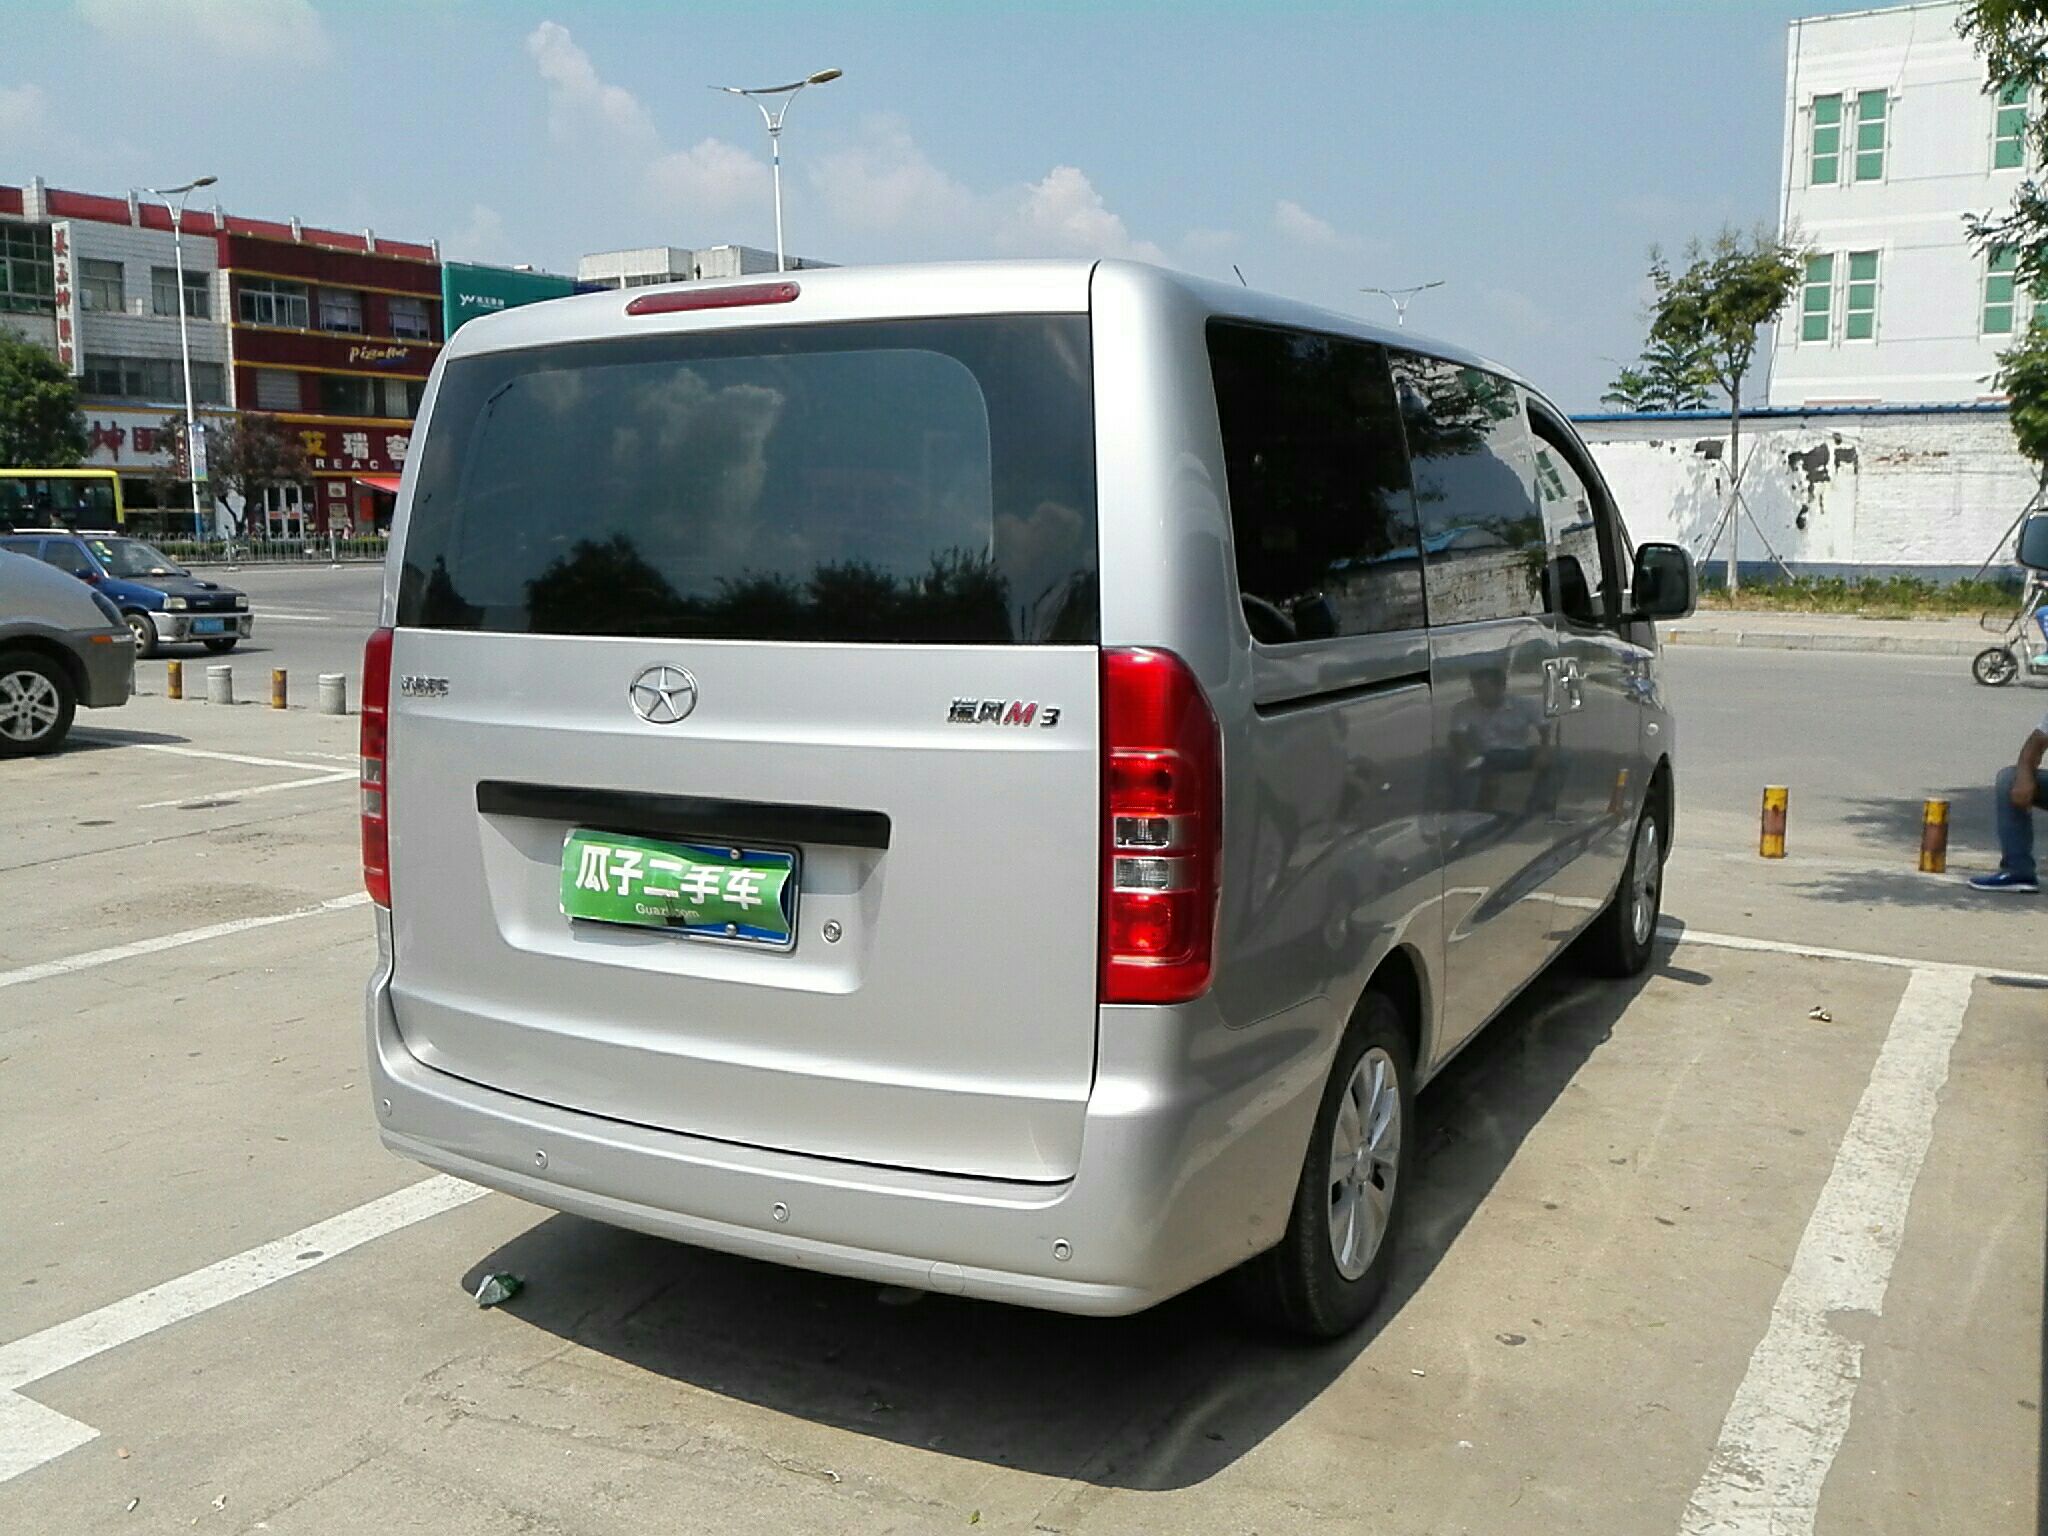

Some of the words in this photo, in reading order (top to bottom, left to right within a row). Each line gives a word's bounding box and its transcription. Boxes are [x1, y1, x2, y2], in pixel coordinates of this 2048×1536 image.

[575, 844, 767, 911] 瓜子二手车
